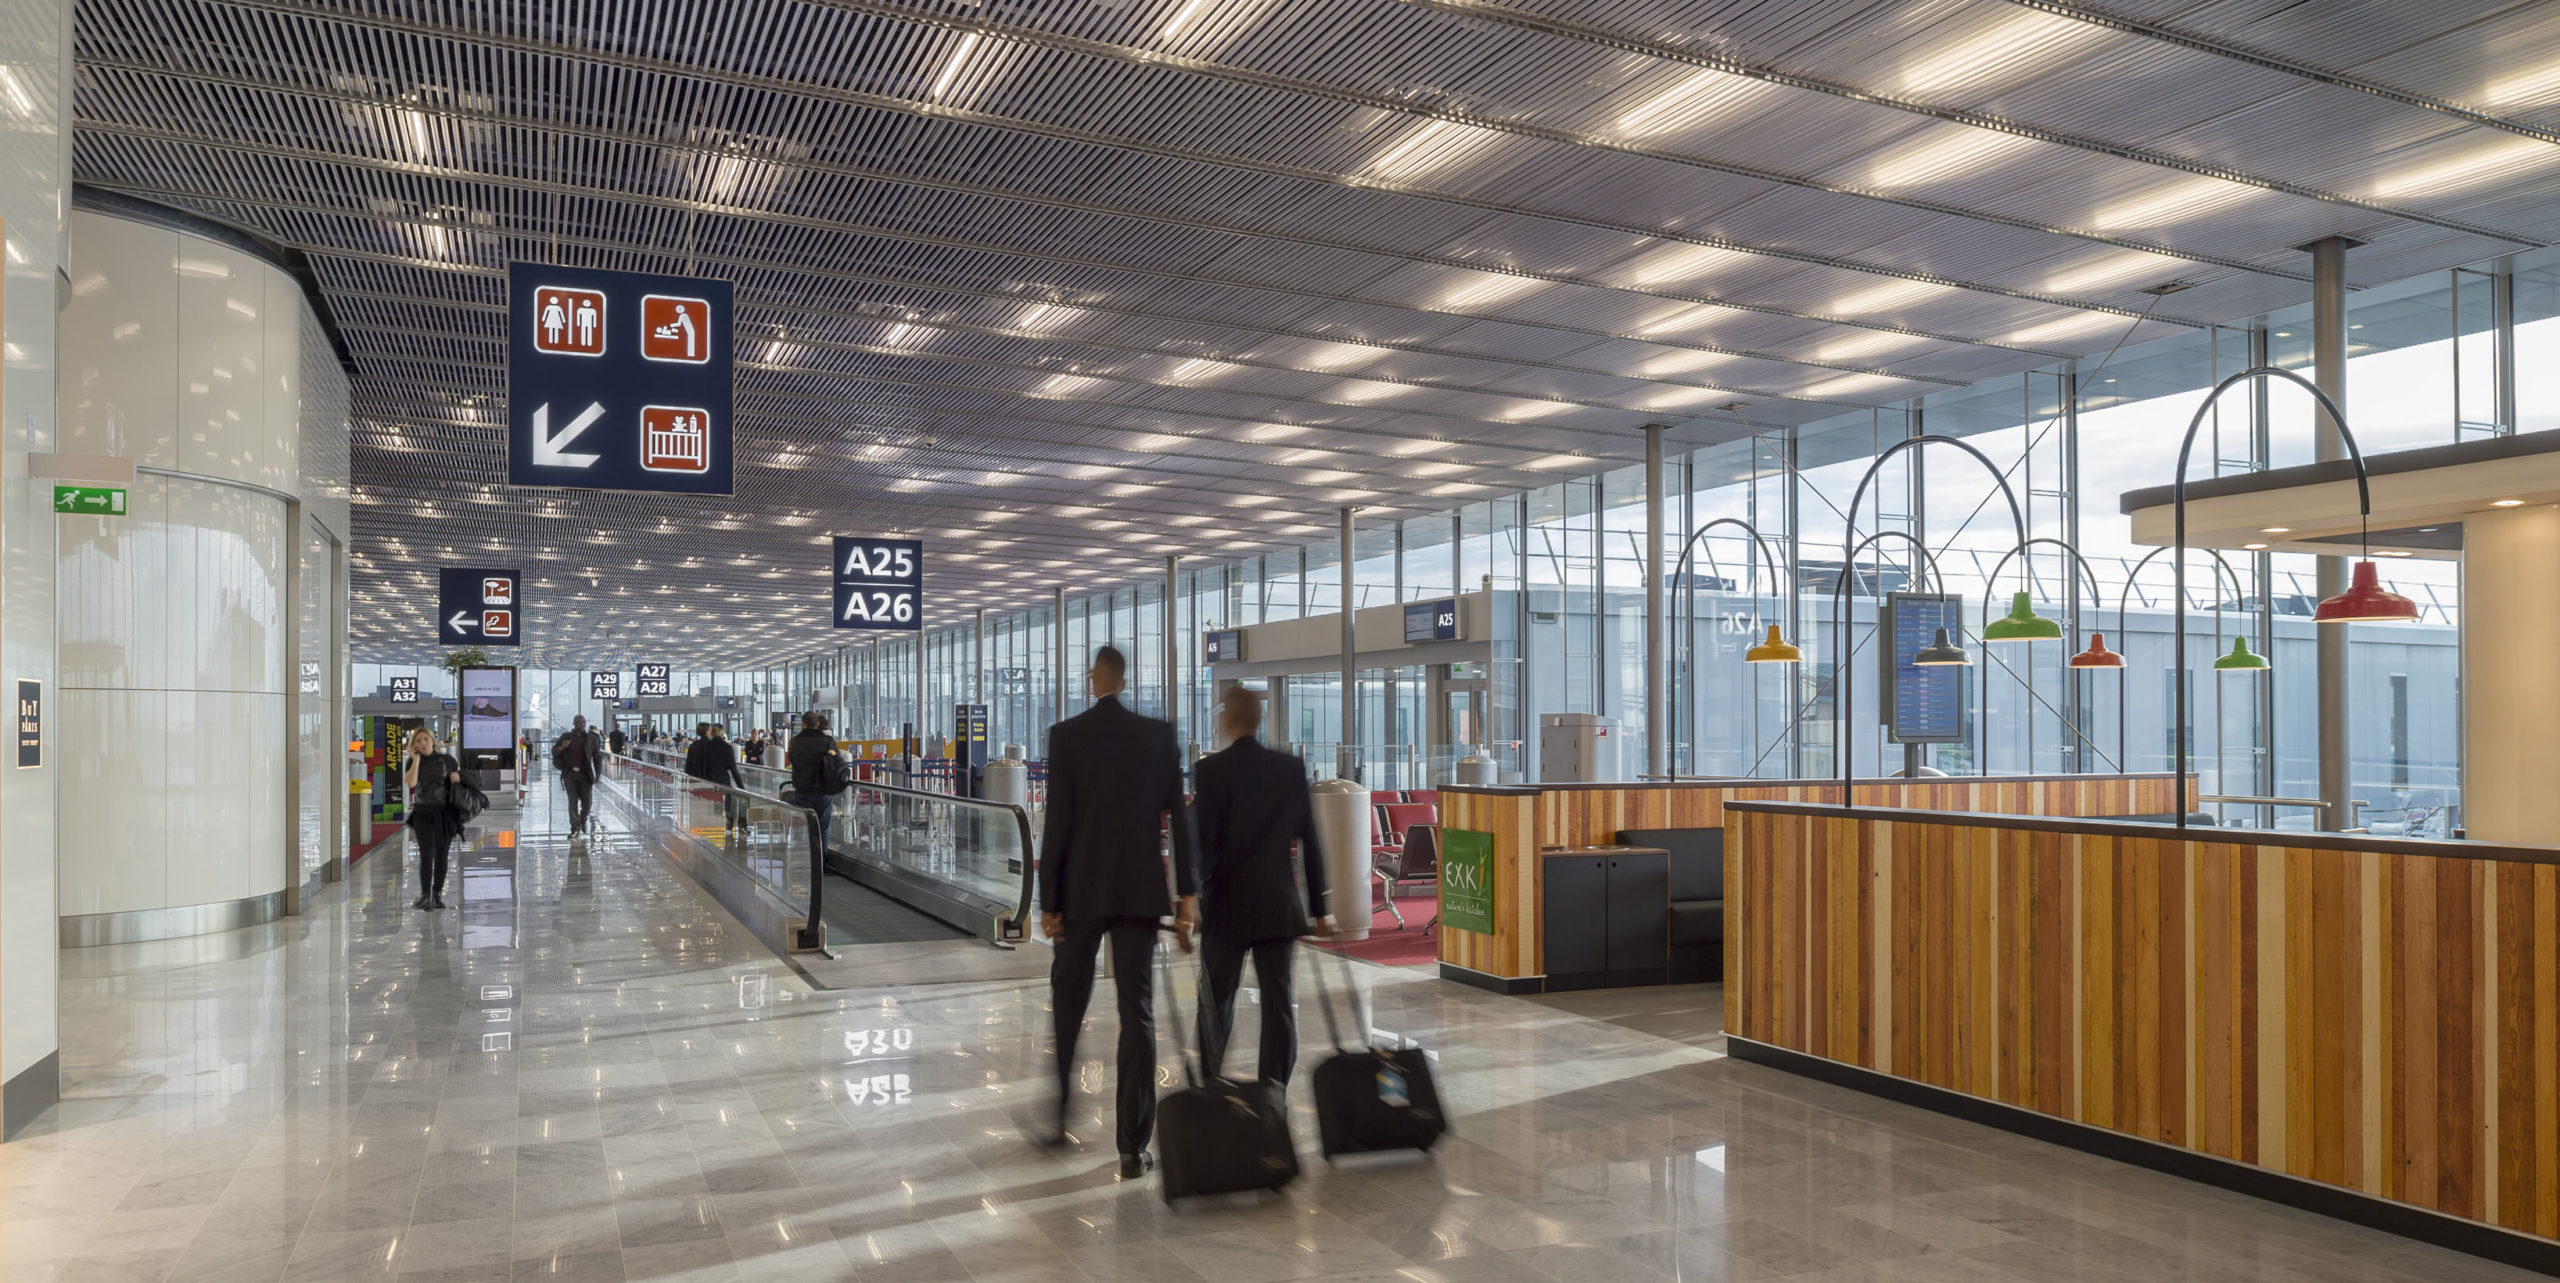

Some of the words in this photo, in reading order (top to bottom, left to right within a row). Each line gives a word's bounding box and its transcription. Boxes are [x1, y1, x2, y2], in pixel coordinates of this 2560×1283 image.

[843, 546, 914, 577] A25
[842, 591, 913, 622] A26
[1438, 613, 1453, 627] A25
[640, 665, 667, 677] A27
[393, 679, 415, 688] A31
[593, 673, 617, 684] A29
[593, 687, 617, 698] A30
[640, 681, 667, 693] A28
[393, 692, 416, 701] A32
[386, 723, 397, 771] ARCADE
